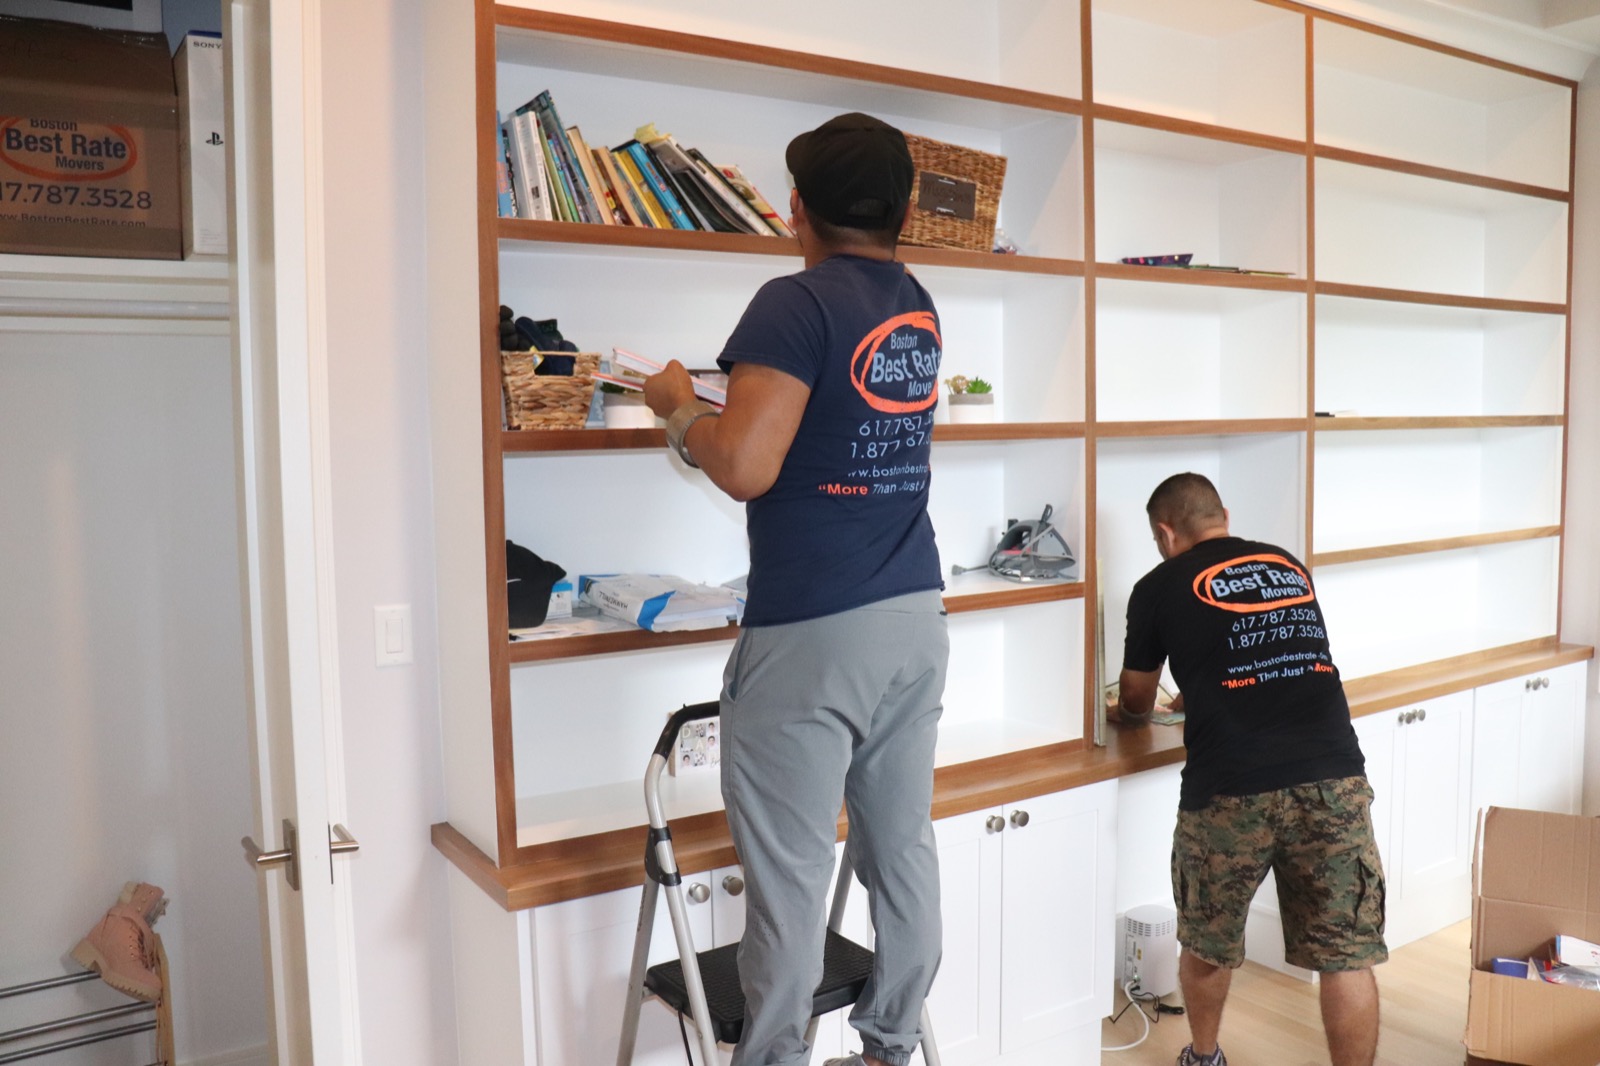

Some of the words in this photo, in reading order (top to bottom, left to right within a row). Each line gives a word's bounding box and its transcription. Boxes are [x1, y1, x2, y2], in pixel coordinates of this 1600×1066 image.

[193, 41, 222, 49] SONY
[30, 118, 78, 131] Boston
[5, 127, 64, 154] Best
[71, 133, 127, 159] Rate
[55, 155, 105, 171] Movers
[890, 332, 918, 351] Boston
[871, 352, 914, 383] Best
[872, 482, 897, 495] Than
[898, 480, 920, 492] Just
[1224, 562, 1270, 576] Boston
[1210, 573, 1268, 598] Best
[1267, 569, 1308, 591] Rate
[1260, 587, 1304, 600] Movers
[1231, 608, 1317, 633] 617.787.3528
[1227, 625, 1325, 650] 1.877.787.3528
[1281, 666, 1304, 679] Just
